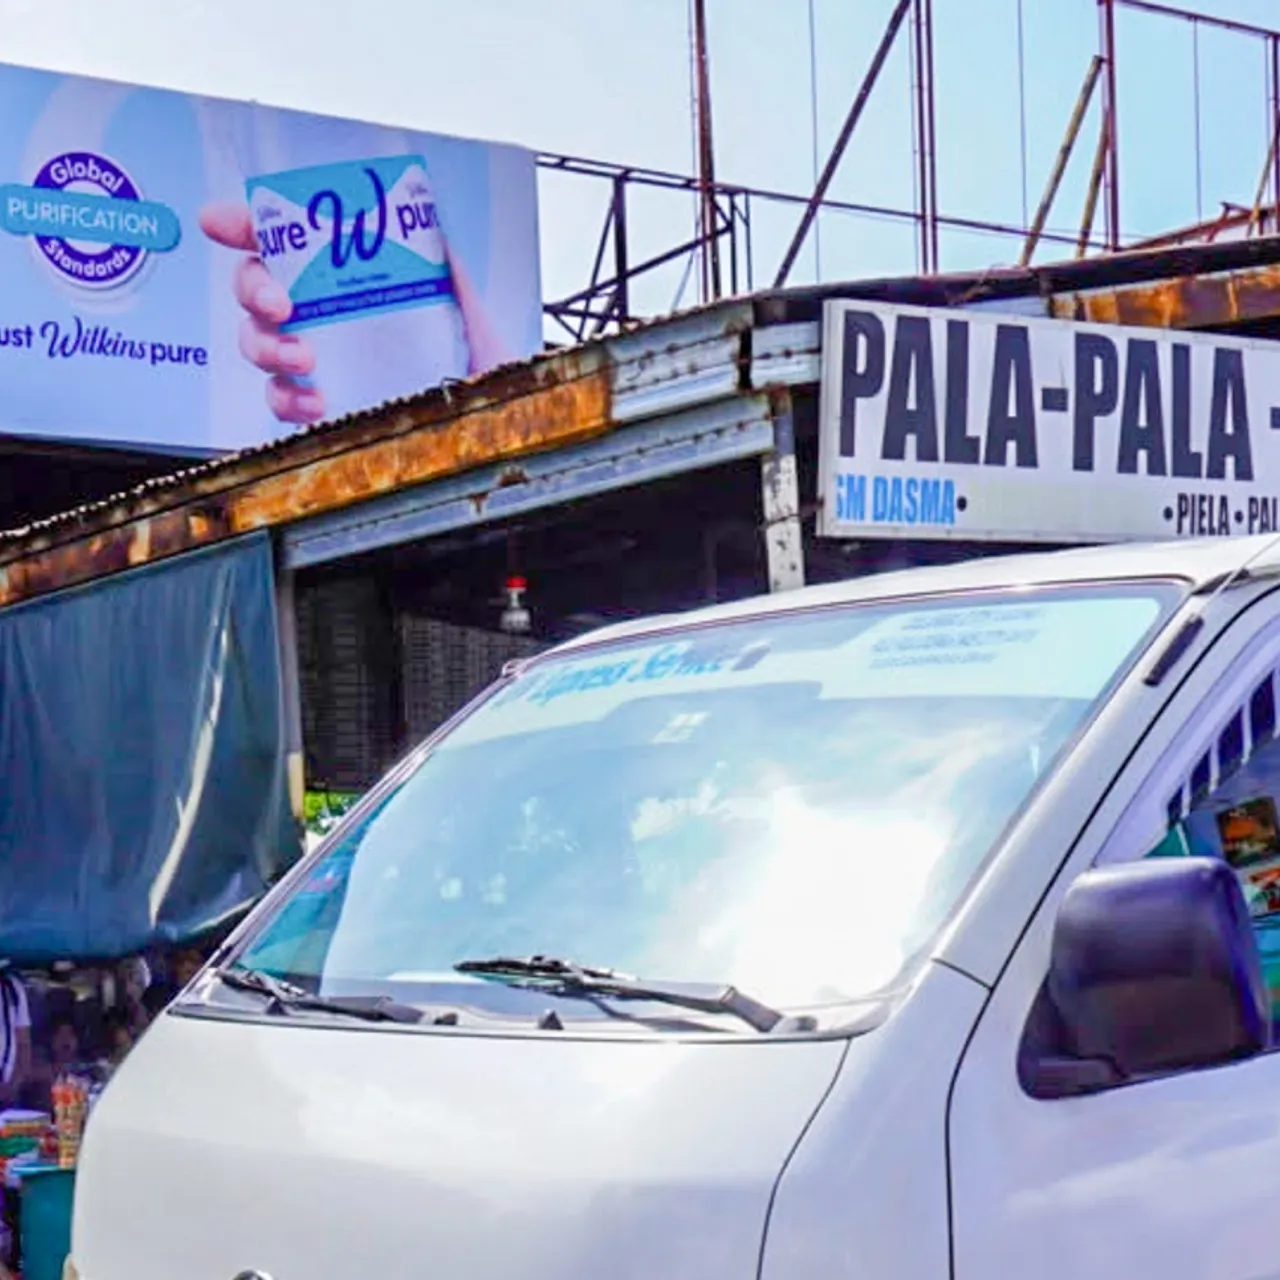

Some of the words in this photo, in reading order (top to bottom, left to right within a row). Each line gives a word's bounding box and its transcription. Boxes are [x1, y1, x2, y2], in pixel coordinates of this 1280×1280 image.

[50, 156, 123, 192] Global
[8, 196, 158, 237] PURIFICATION
[43, 238, 132, 278] Standards
[40, 315, 146, 359] Wilkins
[150, 341, 209, 366] pure
[839, 309, 1255, 482] PALA-PALA
[872, 475, 957, 525] DASMA
[1177, 493, 1231, 536] PIELA
